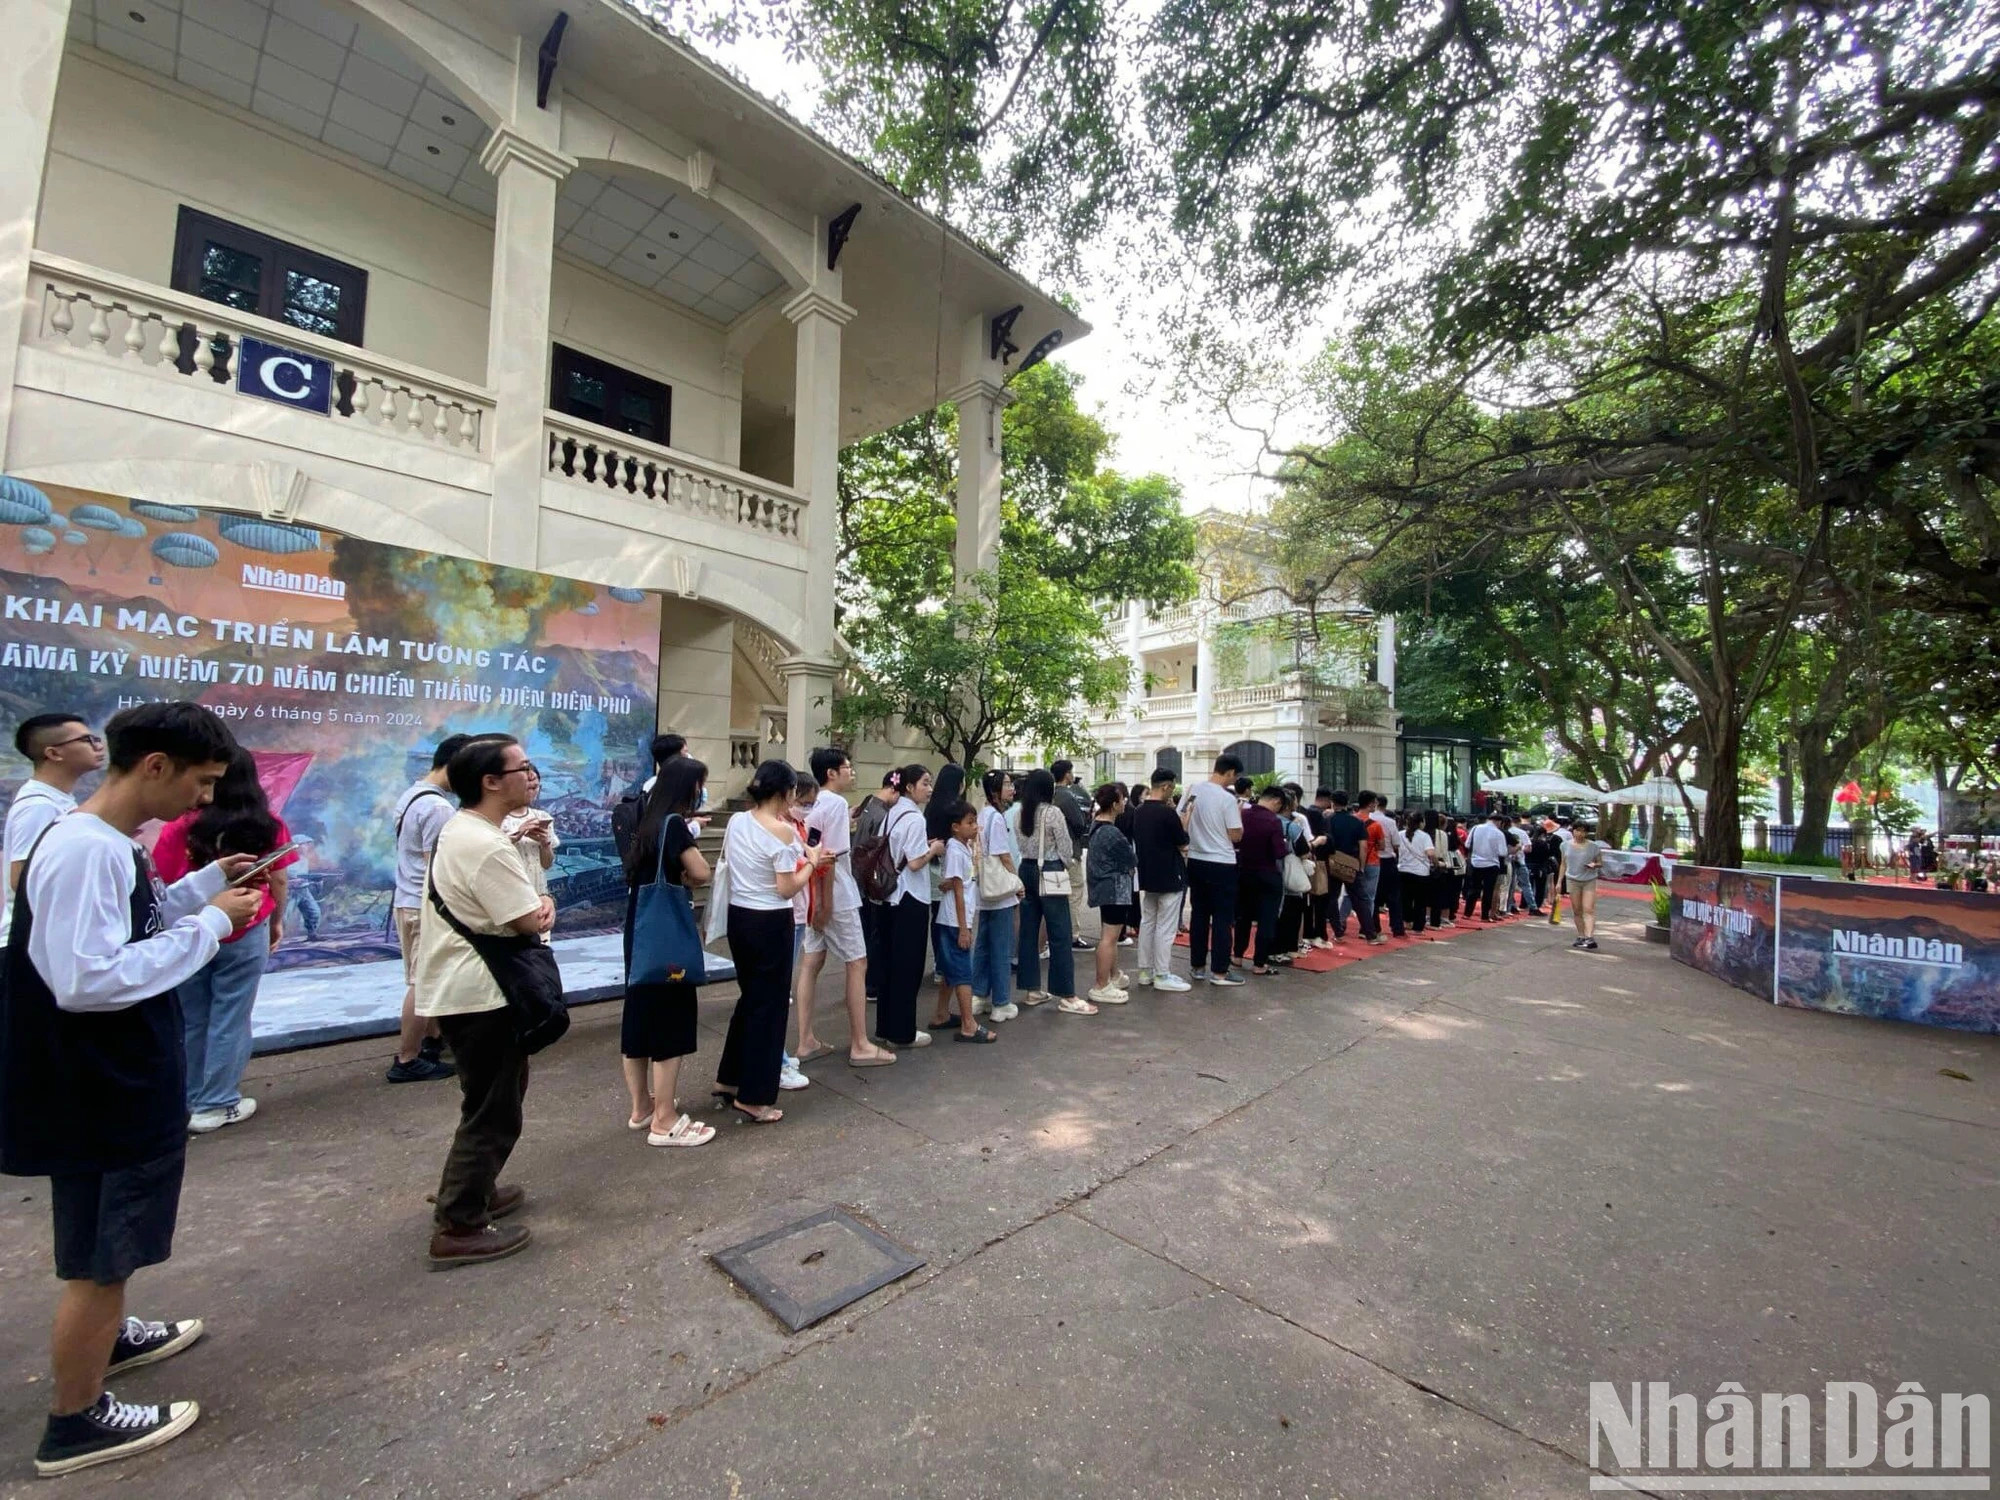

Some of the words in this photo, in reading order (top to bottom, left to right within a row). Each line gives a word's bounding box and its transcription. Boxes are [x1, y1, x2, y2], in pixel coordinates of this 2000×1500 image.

[260, 357, 312, 399] C
[242, 563, 302, 592] Nhân
[303, 573, 346, 597] Dân
[5, 594, 103, 628] KHAI
[117, 607, 199, 640] MẠC
[211, 617, 314, 650] TRIỂN
[399, 640, 490, 667] TƯƠNG
[500, 650, 546, 673] TÁC
[139, 653, 219, 683] NIỆM
[229, 662, 264, 686] 70
[273, 664, 337, 692] NĂM
[345, 670, 415, 698] CHIẾN
[422, 676, 491, 704] THẮNG
[551, 690, 593, 712] BIÊN
[254, 706, 265, 718] 6
[271, 705, 322, 724] tháng
[328, 709, 338, 722] 5
[344, 712, 380, 724] năm
[386, 713, 422, 726] 2024
[1725, 908, 1753, 938] THUẬT
[1832, 929, 1903, 958] Nhân
[1907, 936, 1963, 963] Dân
